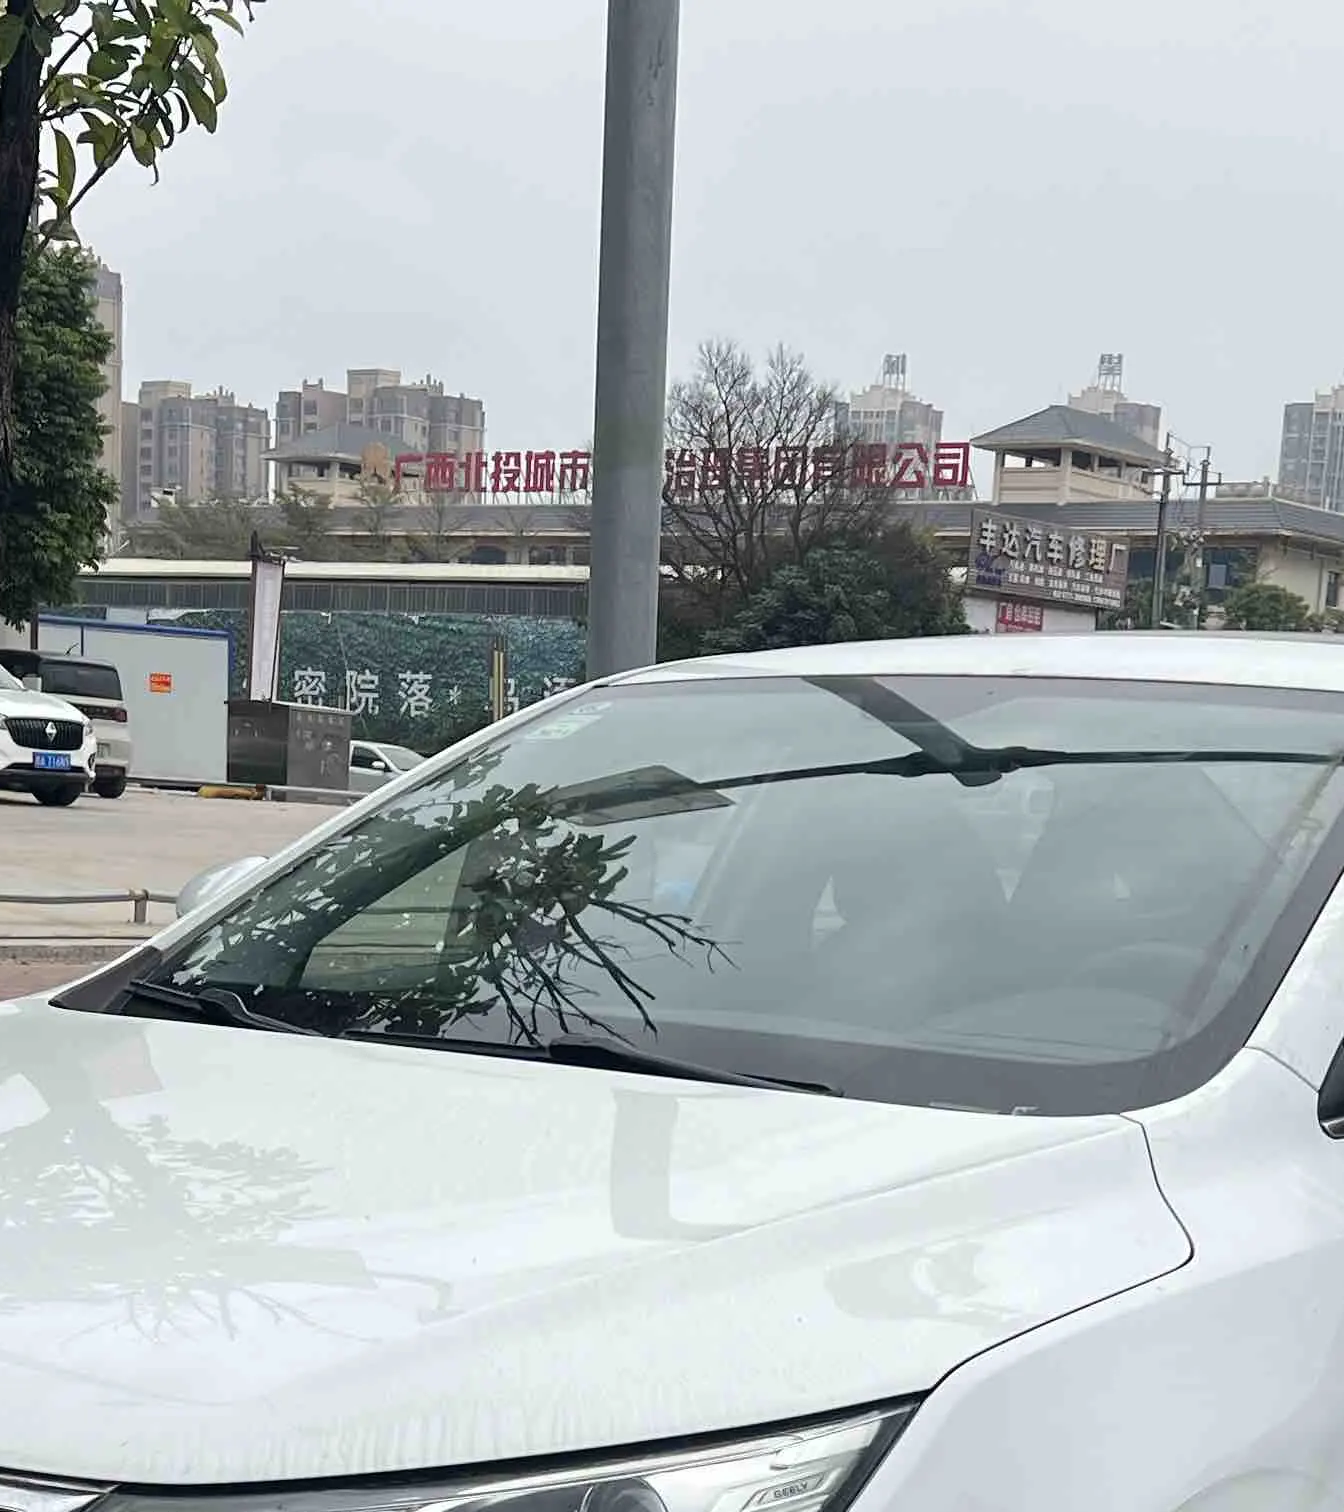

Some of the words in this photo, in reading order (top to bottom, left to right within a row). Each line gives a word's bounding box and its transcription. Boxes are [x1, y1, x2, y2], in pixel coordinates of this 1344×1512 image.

[979, 518, 1127, 574] 丰达汽车修理厂
